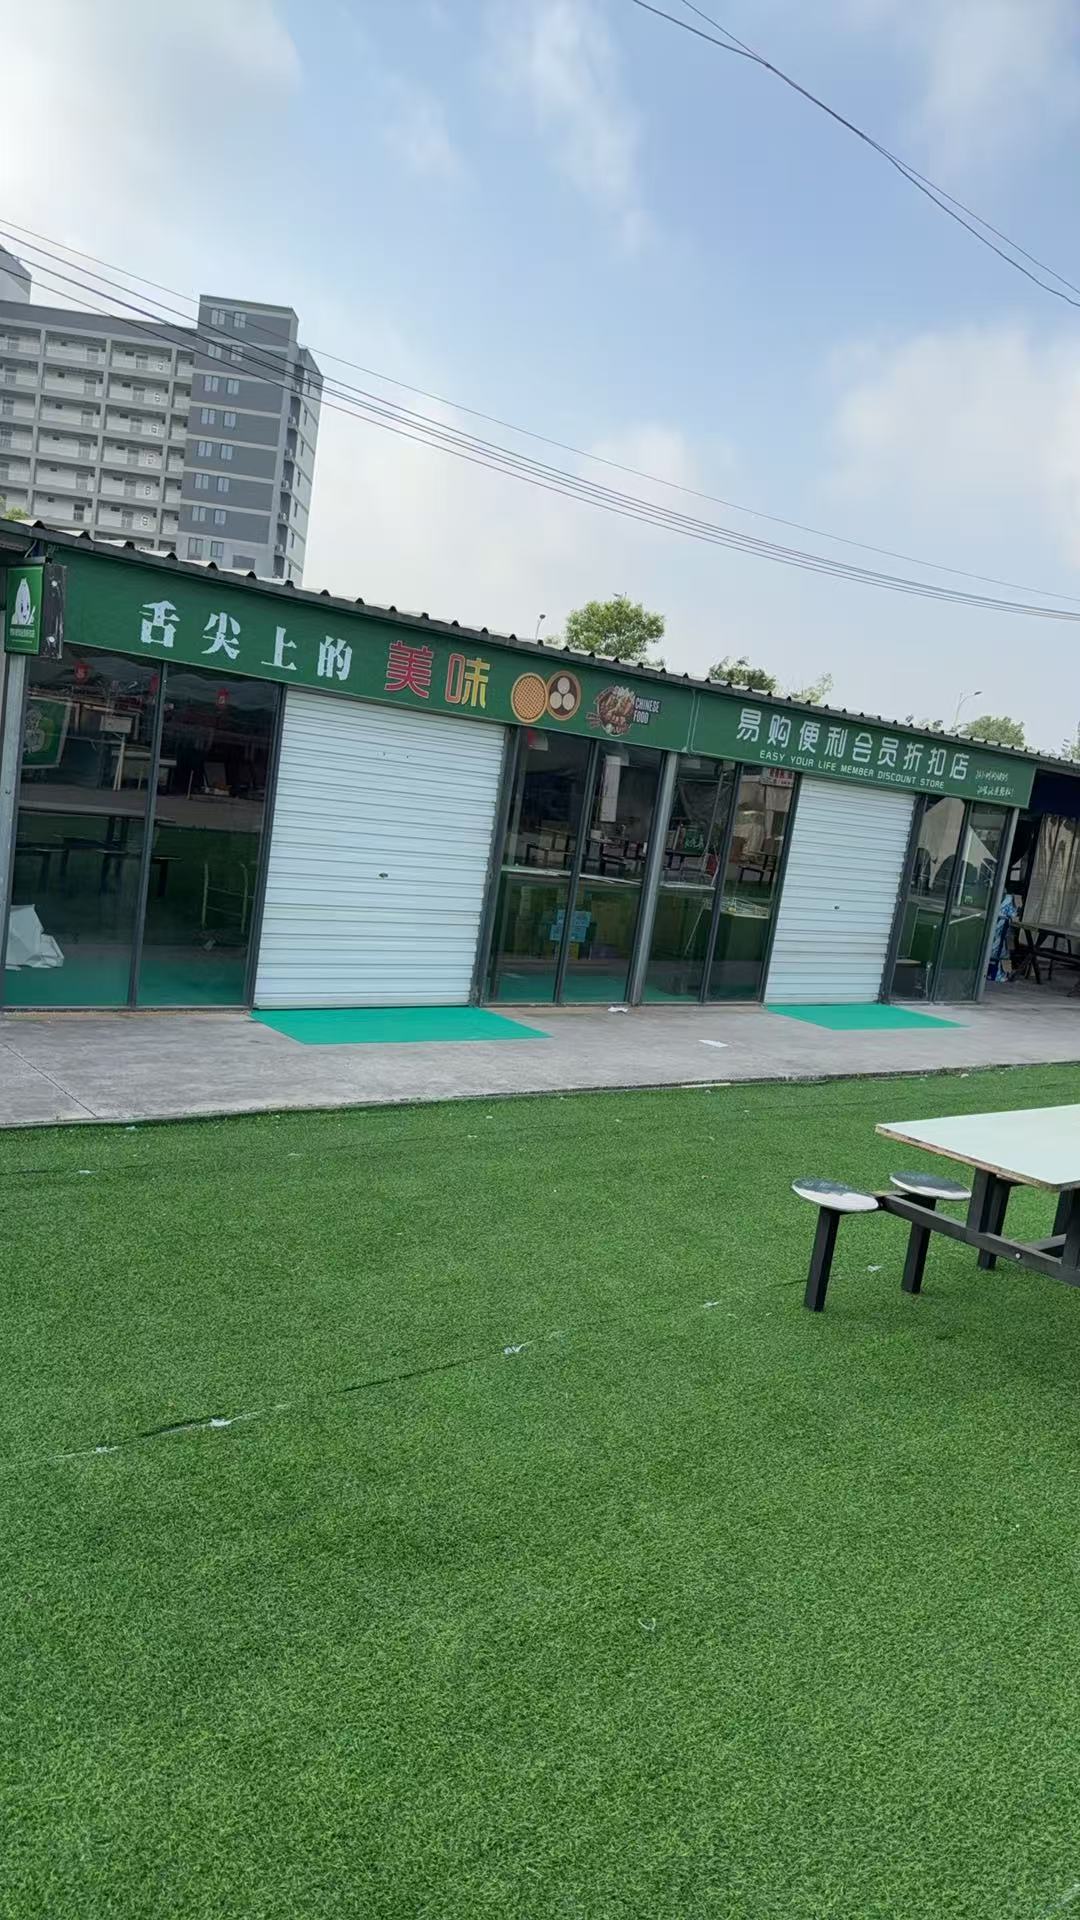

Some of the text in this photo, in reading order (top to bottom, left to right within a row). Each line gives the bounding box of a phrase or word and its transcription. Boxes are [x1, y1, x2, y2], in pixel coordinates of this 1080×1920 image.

[139, 600, 491, 709] 舌尖上的美味
[633, 710, 649, 724] FOOD
[635, 697, 660, 713] CHINESE
[736, 707, 970, 780] 易购便利会员折扣店
[759, 750, 945, 789] EASY YOUR LIFE MEMBER DISCOUNT STORE
